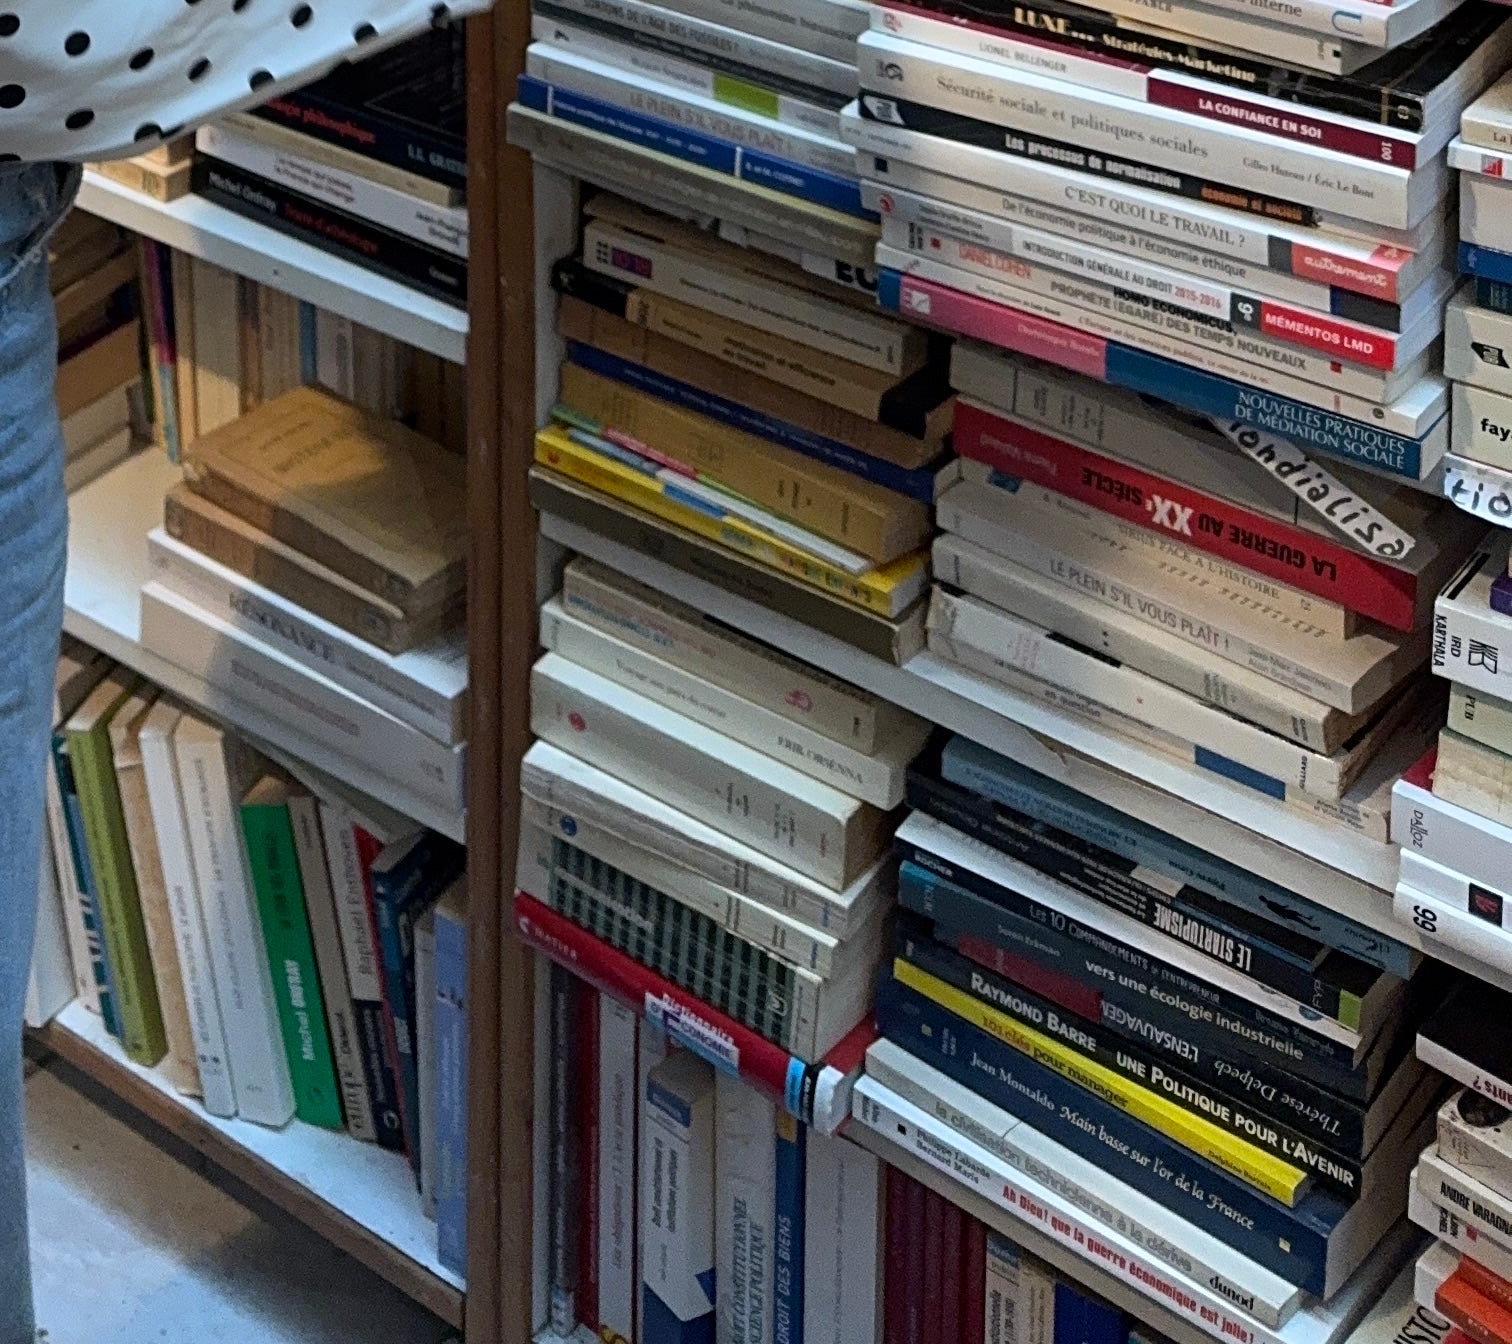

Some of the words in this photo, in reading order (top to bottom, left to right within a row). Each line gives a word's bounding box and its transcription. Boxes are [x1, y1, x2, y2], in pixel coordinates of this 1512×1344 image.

[936, 76, 995, 103] Sécurité
[999, 92, 1047, 119] sociale
[1052, 107, 1067, 121] et
[1071, 111, 1144, 142] politiques
[1150, 130, 1209, 158] sociales
[1199, 98, 1216, 112] LA
[1217, 103, 1279, 128] CONFIANCE
[1282, 119, 1298, 132] EN
[1301, 123, 1322, 139] SOI
[1064, 186, 1105, 207] C'EST
[1108, 196, 1148, 220] QUOI
[1149, 206, 1169, 225] LE
[1173, 214, 1233, 243] TRAVAIL
[1304, 256, 1386, 287] autrement
[1265, 313, 1340, 345] MÉMENTOS
[1344, 335, 1374, 354] LMD
[1235, 404, 1253, 422] DE
[1255, 408, 1340, 448] MÉDIATION
[1343, 437, 1405, 469] SOCIALE
[1238, 392, 1320, 428] NOUVELLES
[1323, 416, 1405, 454] PRATIQUES
[1050, 561, 1067, 577] LE
[1068, 566, 1106, 596] PLEIN
[1138, 600, 1177, 626] VOUS
[1434, 615, 1448, 667] KARTHALA
[1086, 960, 1115, 982] vers
[1119, 973, 1146, 991] une
[1149, 985, 1213, 1023] écologie
[1216, 1014, 1303, 1062] industrielle
[972, 973, 1043, 1024] RAYMOND
[1047, 1013, 1096, 1051] BARRE
[1116, 1051, 1147, 1078] UNE
[1150, 1067, 1230, 1121] POLITIQUE
[1235, 1114, 1278, 1143] POUR
[1002, 1186, 1017, 1202] Ah
[1051, 1214, 1071, 1236] que
[1074, 1227, 1085, 1244] la
[1087, 1236, 1126, 1269] guerre
[1129, 1261, 1197, 1310] économique
[1200, 1306, 1219, 1324] est
[1209, 1275, 1255, 1310] dunod
